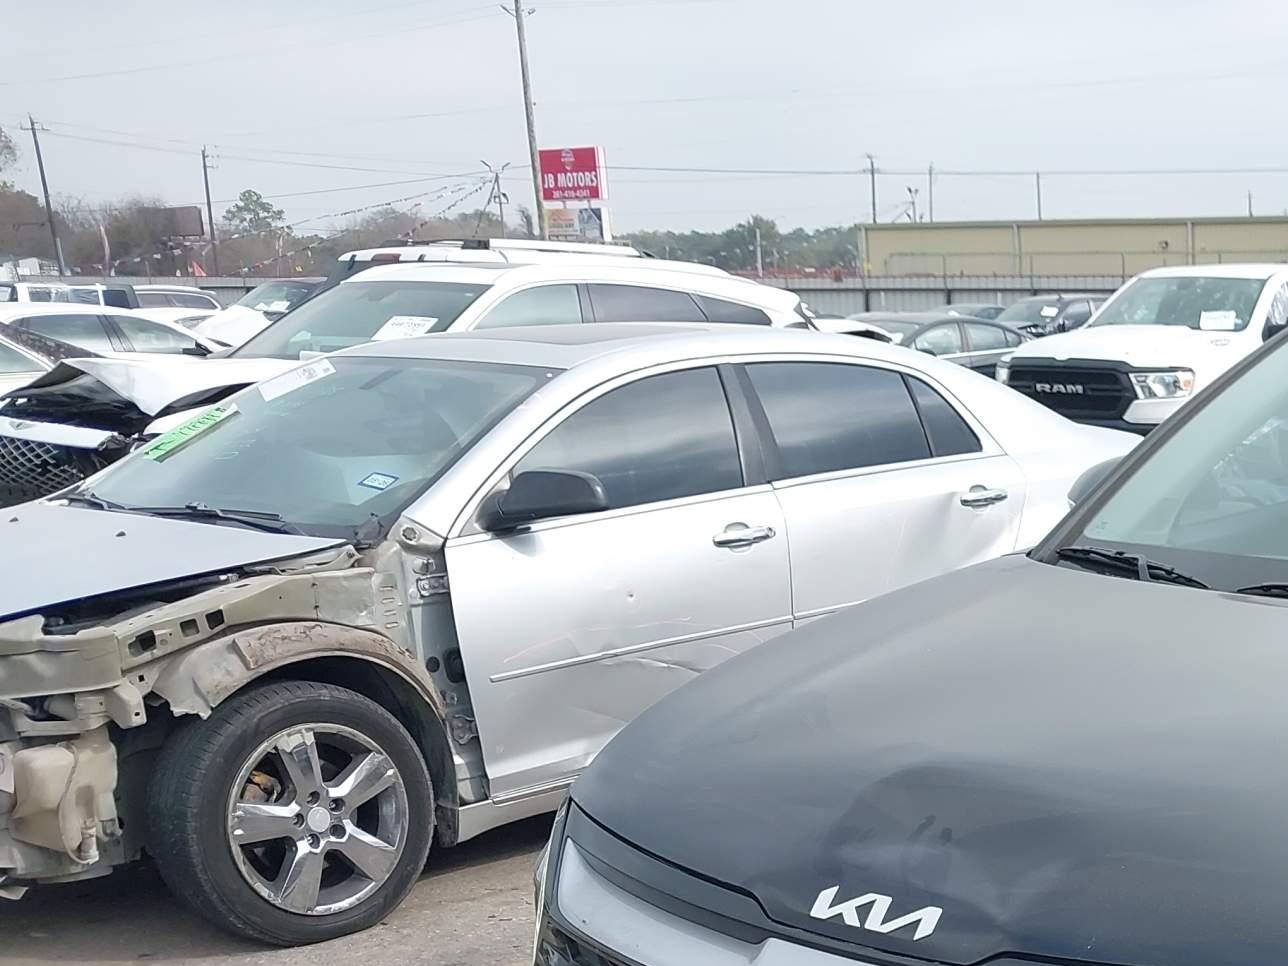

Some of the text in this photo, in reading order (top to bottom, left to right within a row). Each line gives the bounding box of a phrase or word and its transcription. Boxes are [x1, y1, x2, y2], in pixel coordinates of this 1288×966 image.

[544, 171, 597, 188] JB MOTORS
[1035, 383, 1084, 394] RAM
[810, 885, 943, 941] KIA
